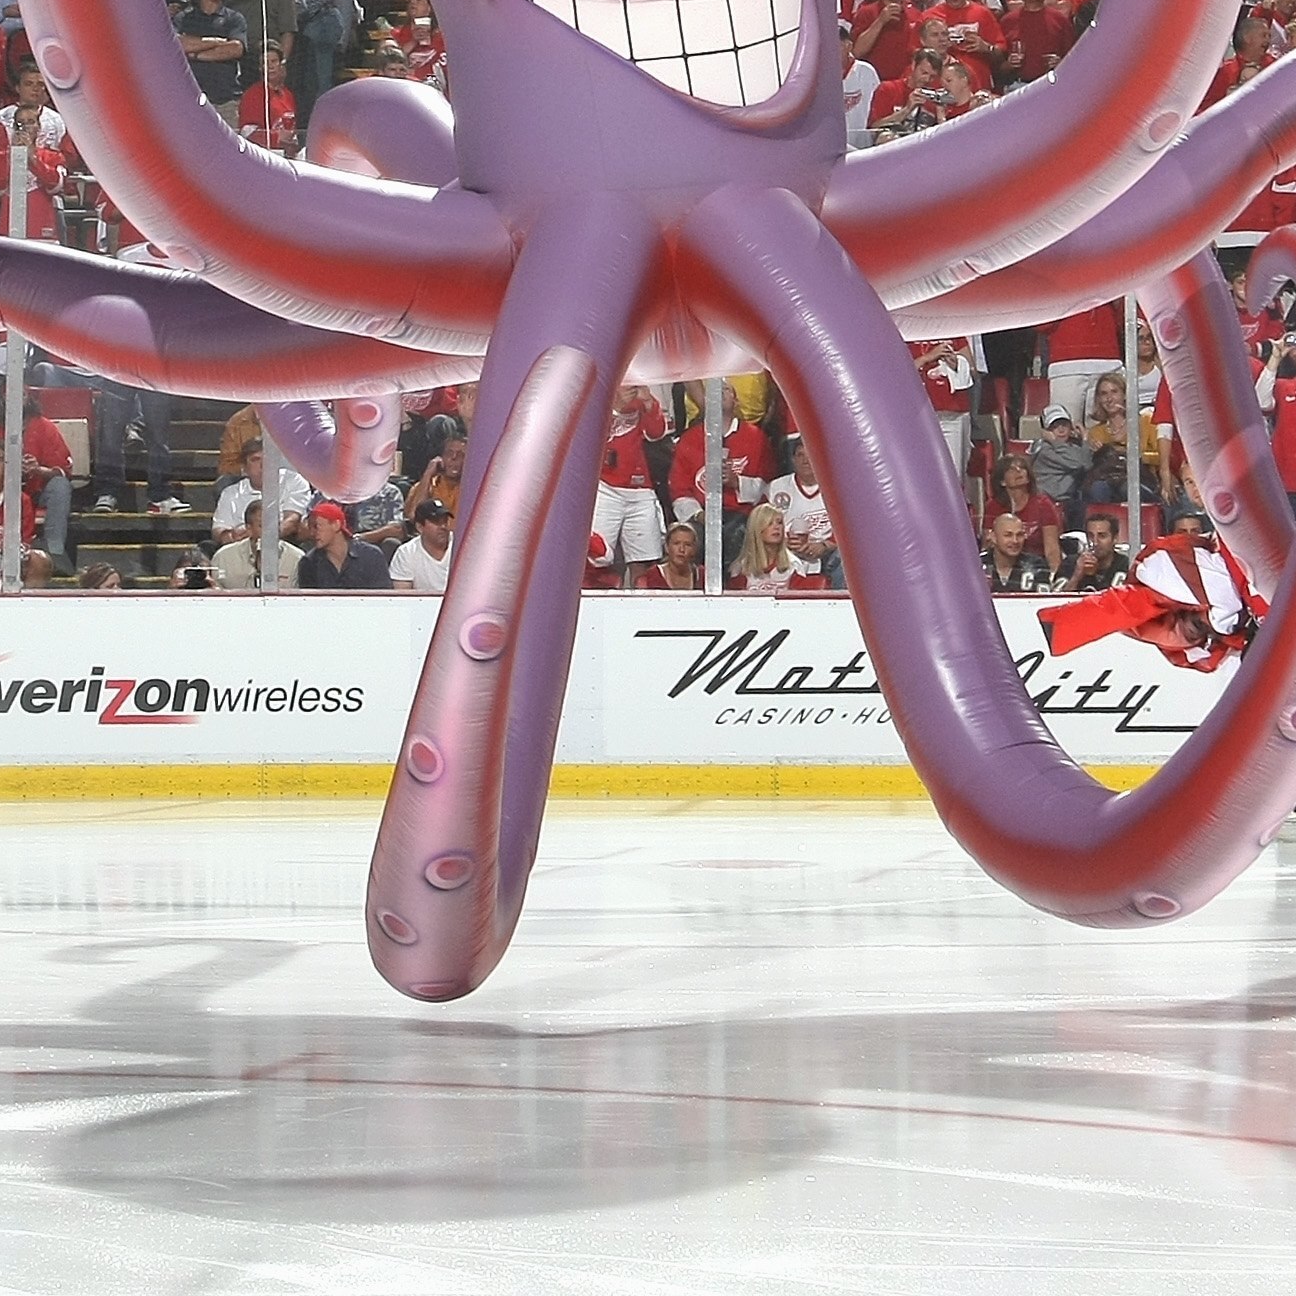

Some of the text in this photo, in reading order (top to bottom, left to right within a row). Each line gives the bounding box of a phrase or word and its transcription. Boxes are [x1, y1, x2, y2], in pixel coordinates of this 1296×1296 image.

[634, 629, 881, 699] Mot
[213, 679, 365, 713] wireless
[714, 707, 891, 726] CASINO HO
